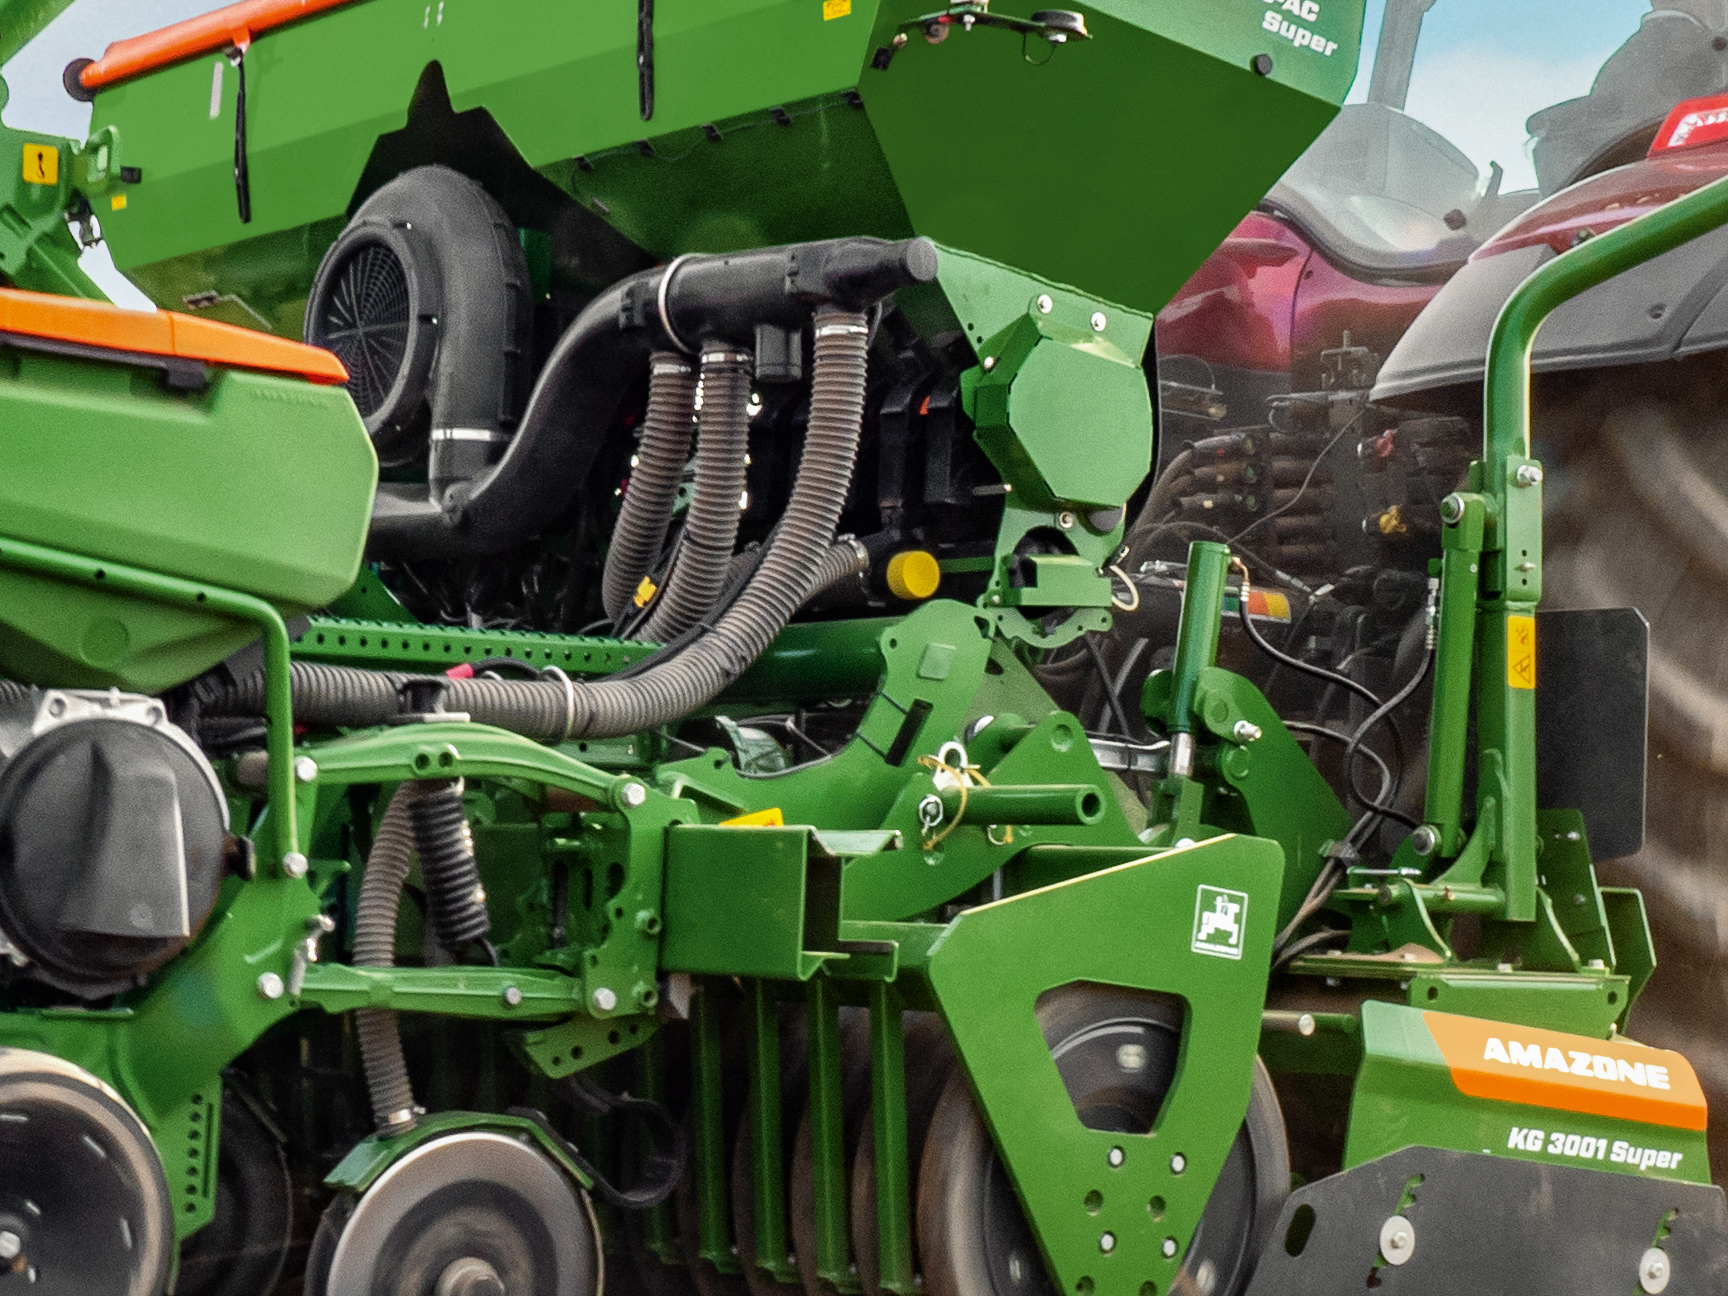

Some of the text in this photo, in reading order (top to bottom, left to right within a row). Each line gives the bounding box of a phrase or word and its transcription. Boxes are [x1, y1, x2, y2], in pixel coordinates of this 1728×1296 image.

[1262, 8, 1337, 57] Super
[1483, 1037, 1671, 1090] AMAZONE
[1507, 1126, 1682, 1171] KG 3001 Super
